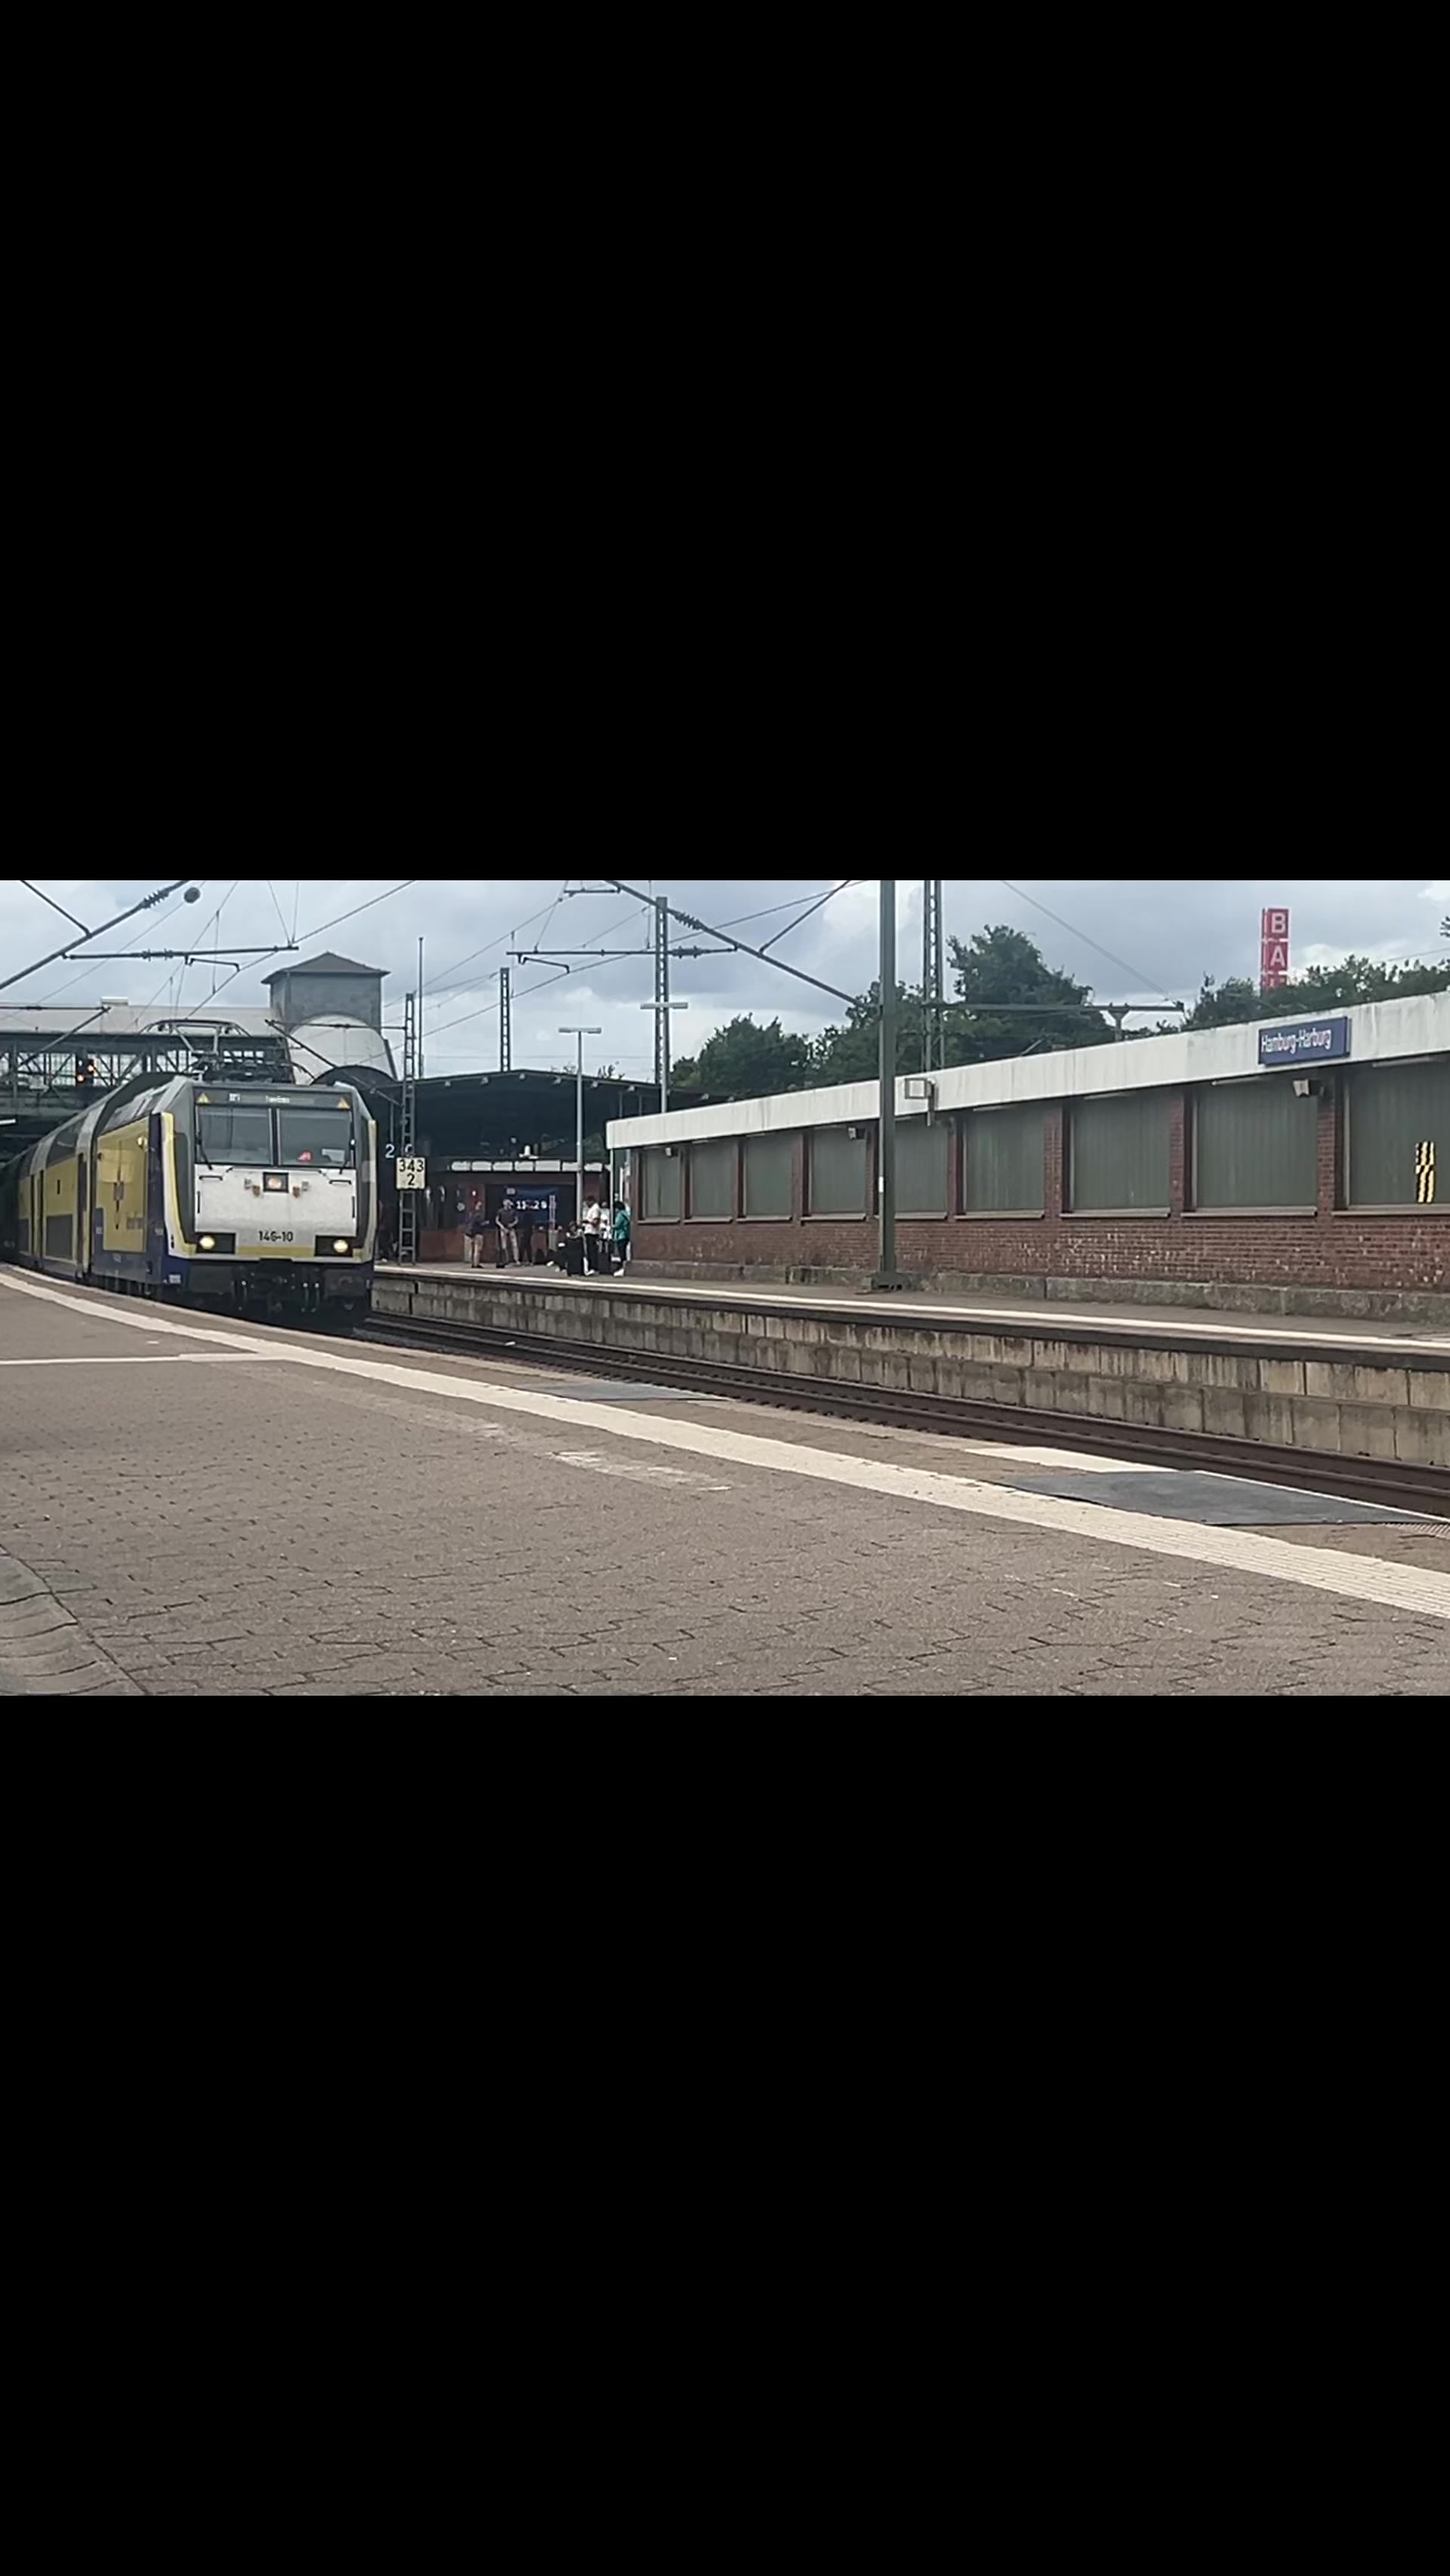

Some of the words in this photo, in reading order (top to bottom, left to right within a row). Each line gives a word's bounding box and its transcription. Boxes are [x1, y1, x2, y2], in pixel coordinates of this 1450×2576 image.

[1261, 1028, 1331, 1055] Hamburg-Harburg
[385, 1144, 395, 1158] 2
[399, 1159, 424, 1172] 343
[407, 1172, 415, 1185] 2
[259, 1231, 294, 1242] 146-10
